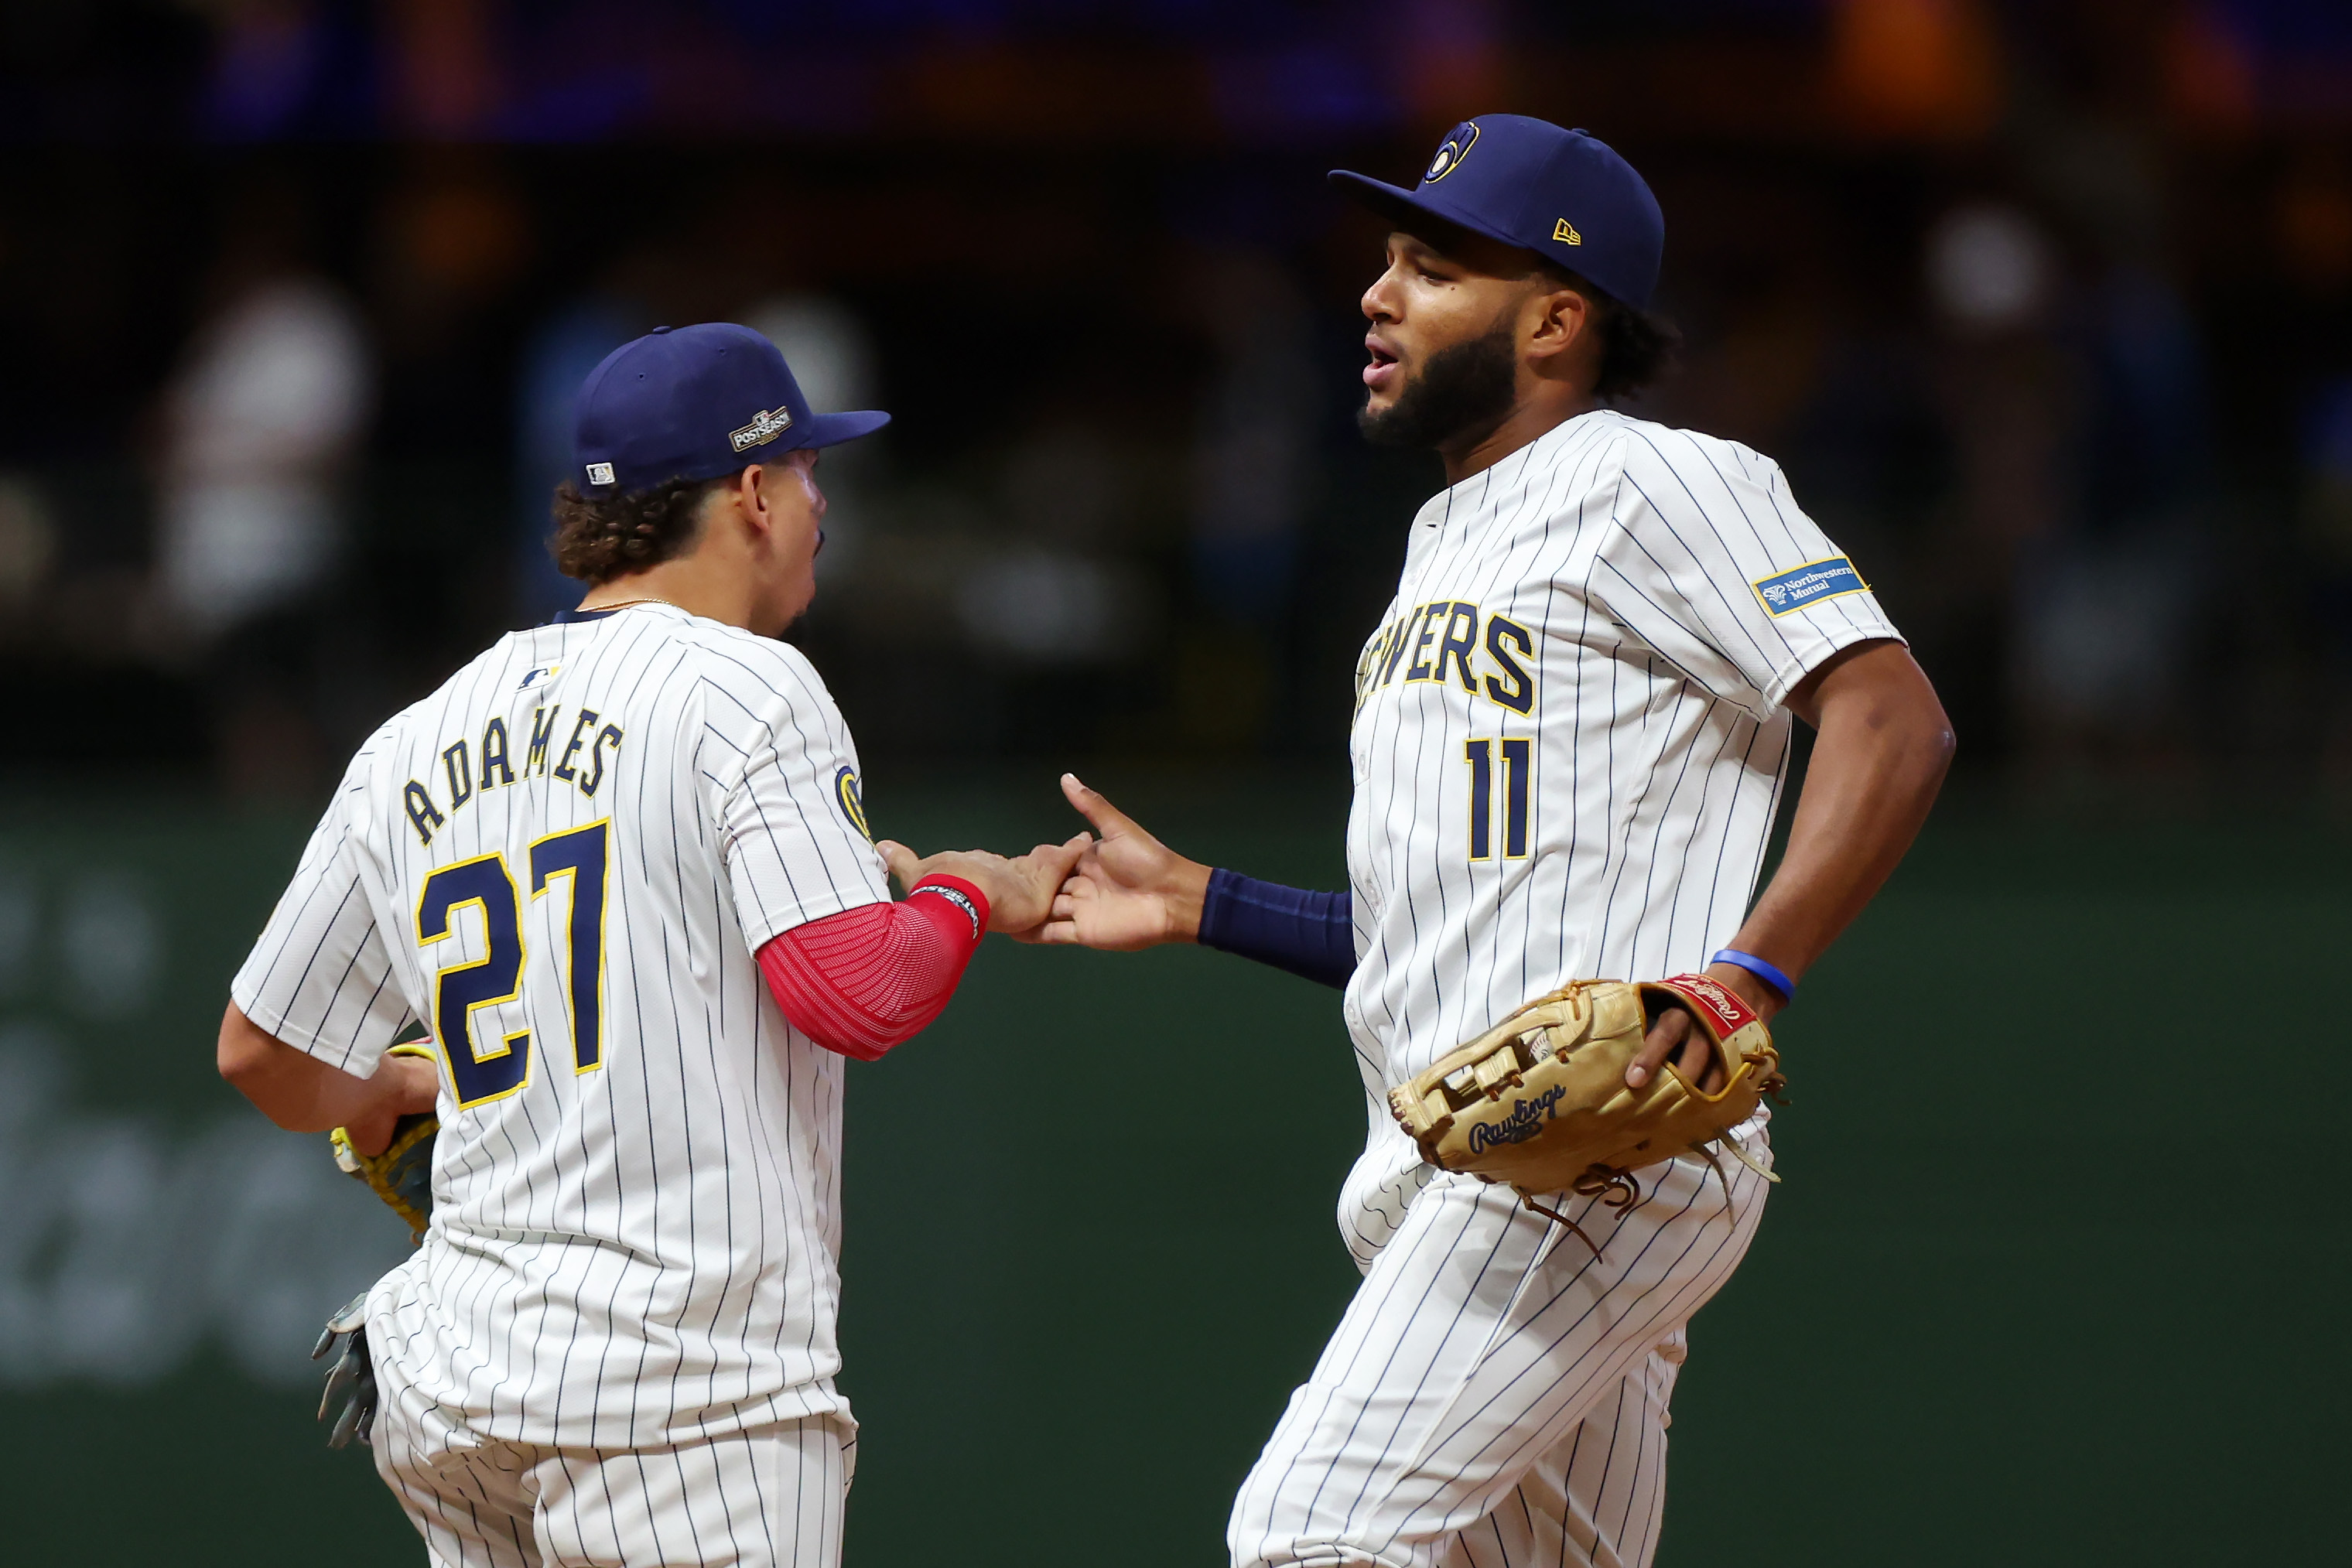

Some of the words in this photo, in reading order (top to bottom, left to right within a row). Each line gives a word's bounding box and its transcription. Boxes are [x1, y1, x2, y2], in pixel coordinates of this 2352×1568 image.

[1784, 567, 1854, 591] Northwestern
[1790, 580, 1831, 600] Mutual
[1352, 599, 1536, 726] EWERS
[403, 704, 625, 849] ADAMES
[1464, 737, 1533, 863] 11
[415, 815, 611, 1112] 27
[1468, 1084, 1567, 1154] Rawlings
